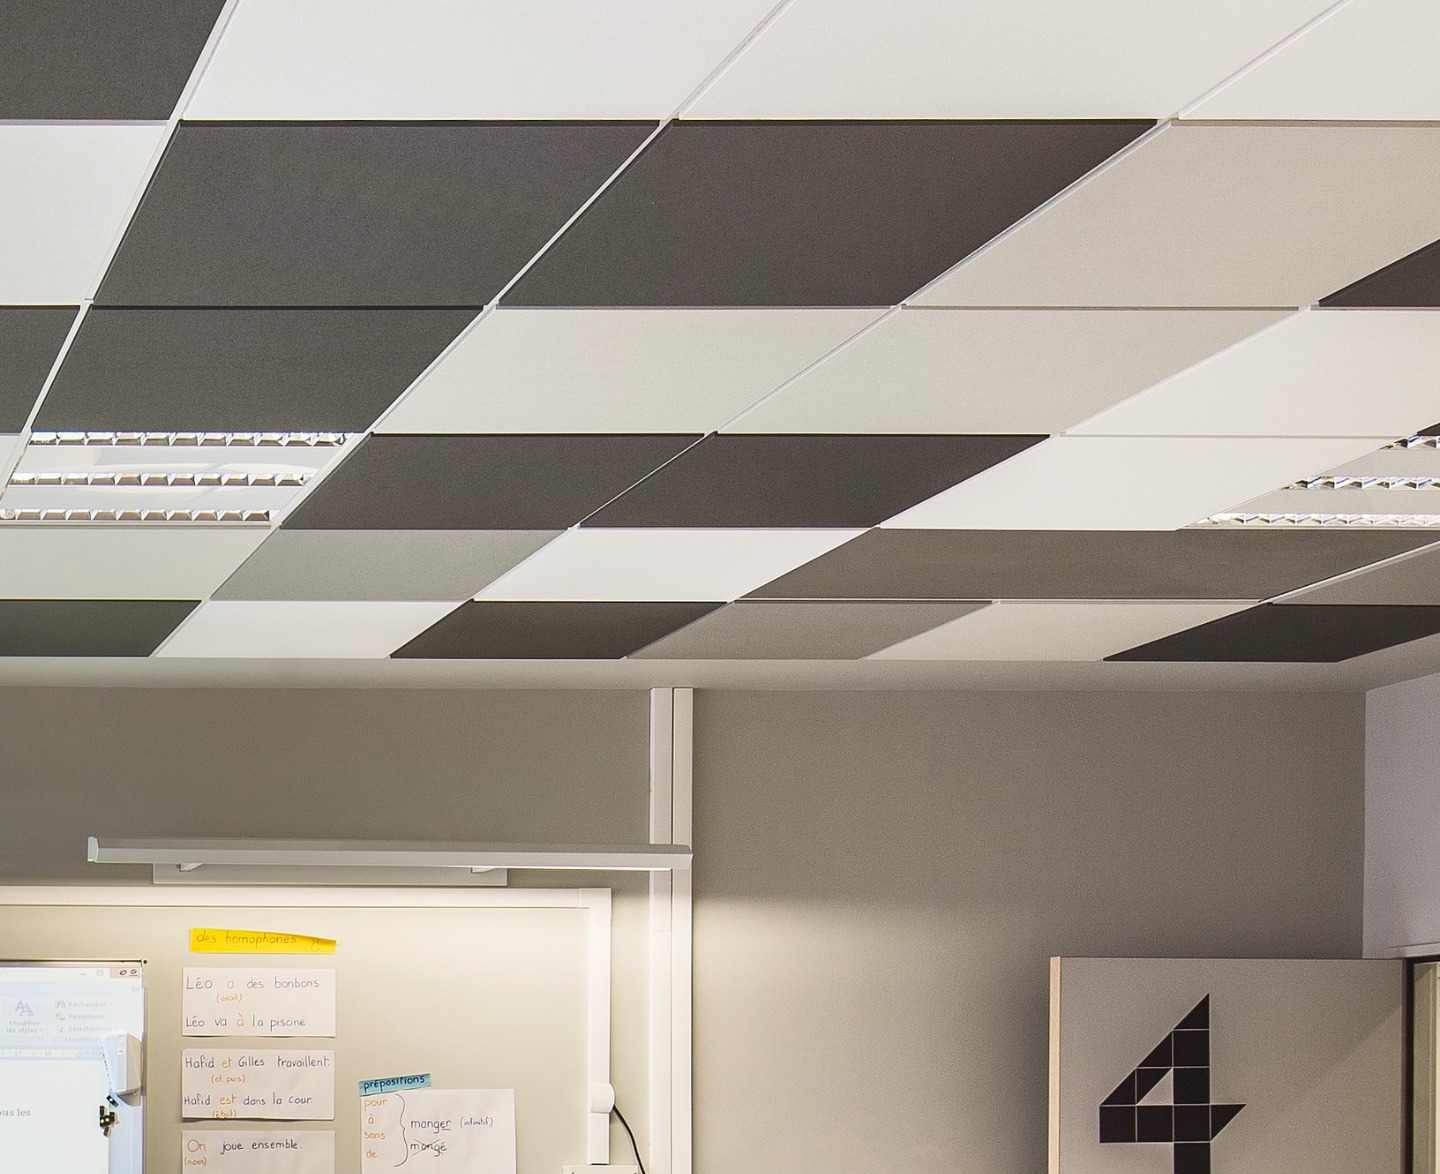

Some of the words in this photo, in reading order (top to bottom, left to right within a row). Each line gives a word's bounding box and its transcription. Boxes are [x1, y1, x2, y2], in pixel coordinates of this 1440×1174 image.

[197, 930, 217, 944] des
[225, 932, 297, 949] homophones
[187, 977, 212, 990] Léo
[227, 979, 235, 989] a
[247, 977, 264, 989] des
[186, 1016, 204, 1028] Léo
[215, 1017, 227, 1026] va
[237, 1014, 244, 1027] à
[253, 1015, 264, 1028] la
[185, 1056, 214, 1069] Hafid
[222, 1058, 232, 1068] et
[238, 1056, 265, 1067] Gilles
[364, 1075, 425, 1092] prépositions
[411, 1118, 451, 1132] manger
